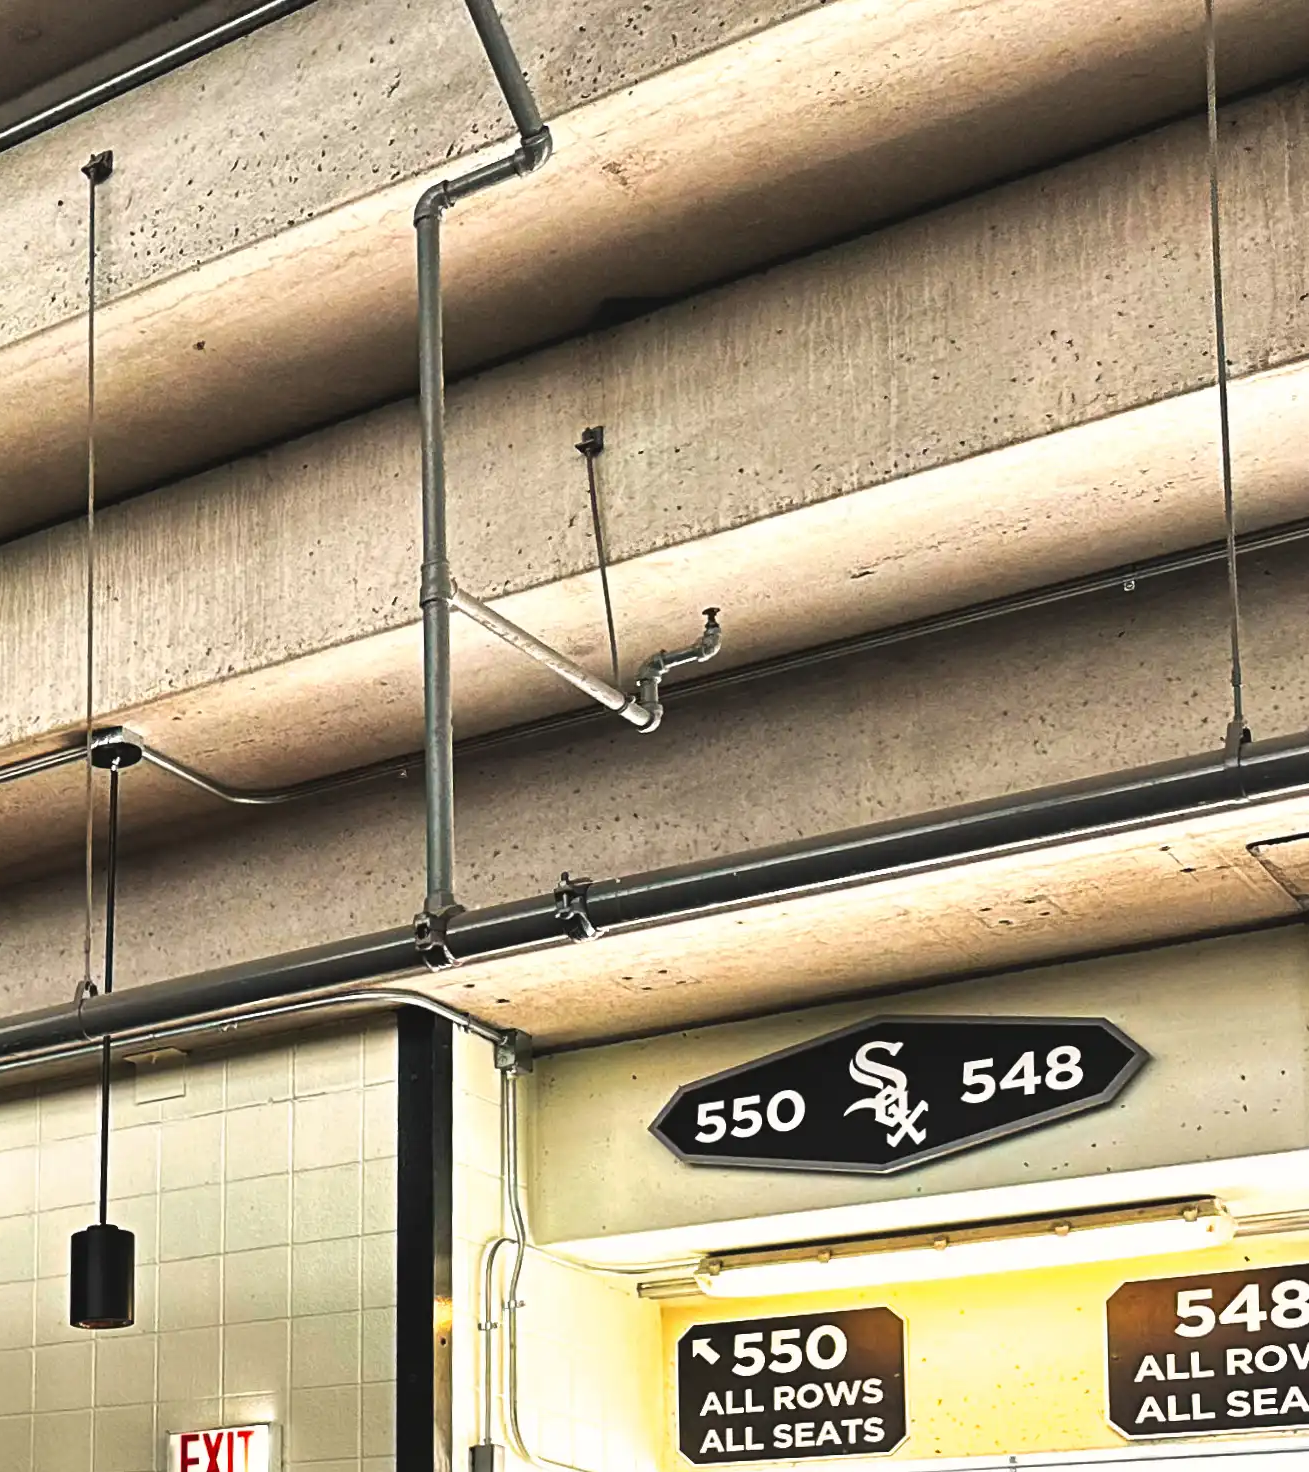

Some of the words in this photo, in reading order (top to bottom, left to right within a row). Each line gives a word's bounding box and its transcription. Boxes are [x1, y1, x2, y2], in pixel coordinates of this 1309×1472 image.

[694, 1089, 806, 1144] 550
[960, 1044, 1084, 1104] 548
[1174, 1279, 1309, 1338] 548
[732, 1324, 848, 1377] 550
[1133, 1350, 1215, 1383] ALL
[699, 1388, 765, 1417] ALL
[773, 1377, 884, 1411] ROWS
[1134, 1392, 1216, 1424] ALL
[699, 1426, 765, 1454] ALL
[773, 1416, 886, 1449] SEATS
